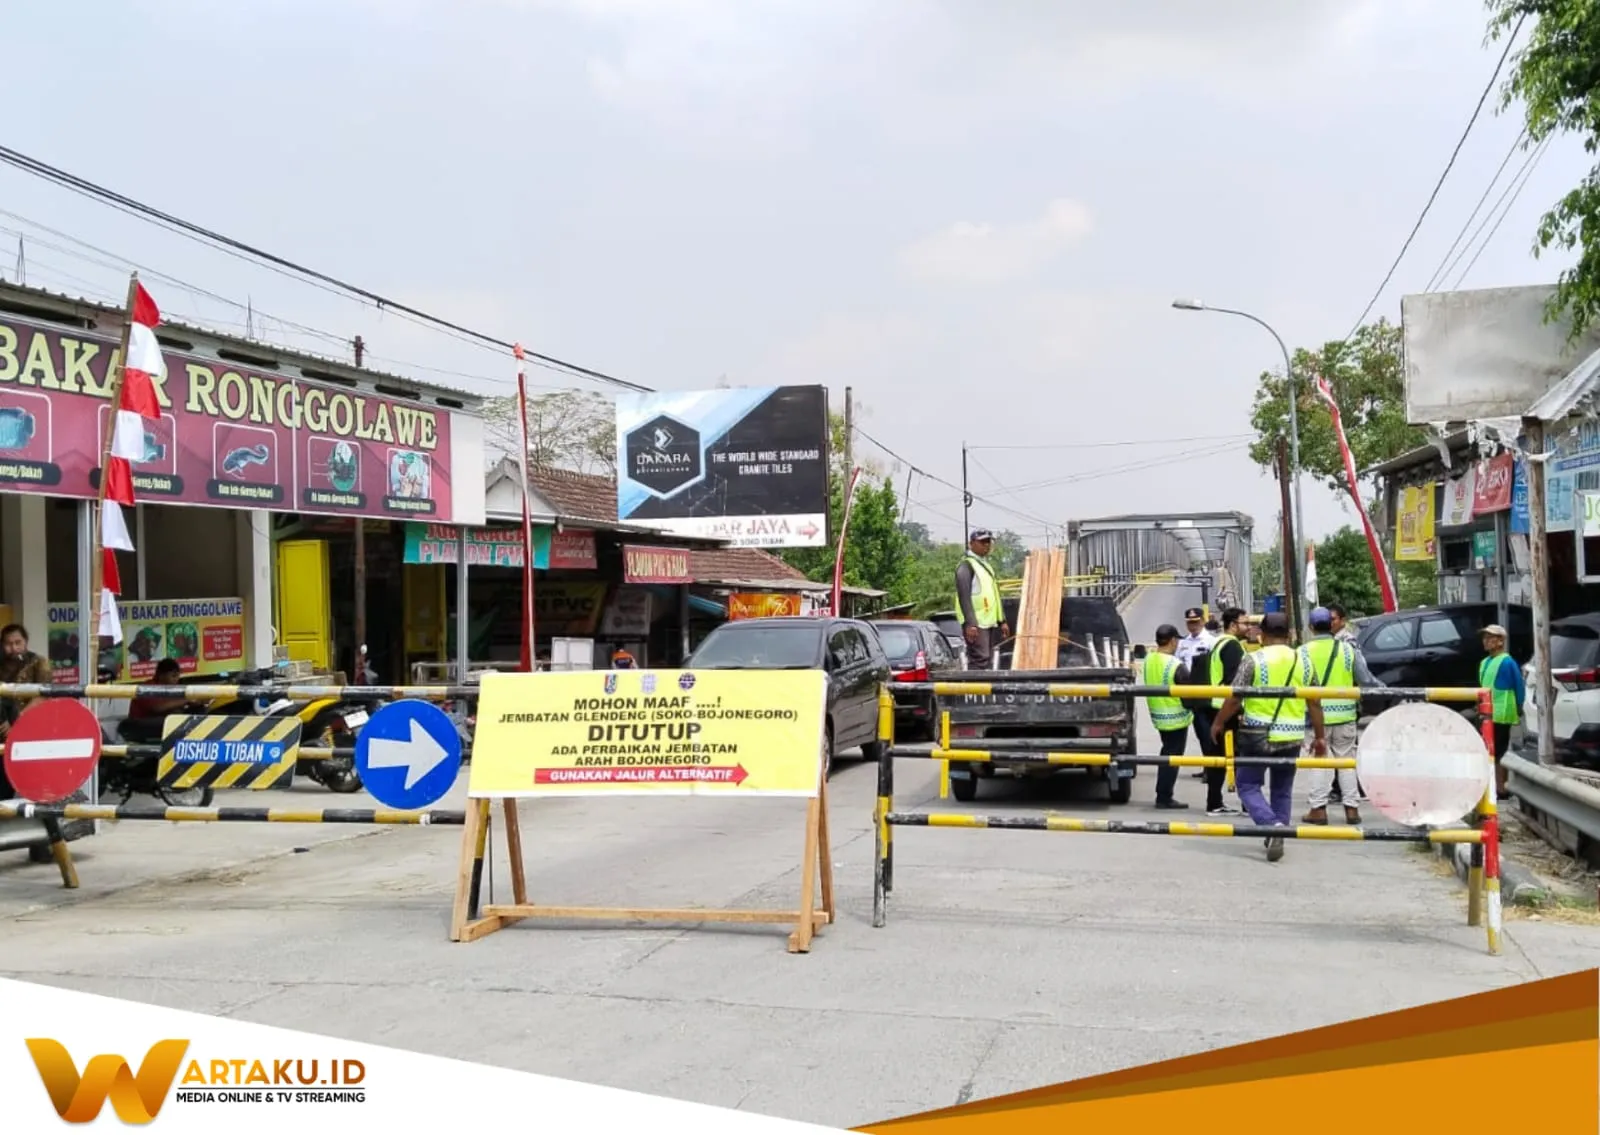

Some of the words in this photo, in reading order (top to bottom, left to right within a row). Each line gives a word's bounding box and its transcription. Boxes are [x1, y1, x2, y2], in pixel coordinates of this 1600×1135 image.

[184, 363, 438, 450] RONGGOLAWE
[636, 452, 691, 465] DAKARA
[712, 453, 726, 463] THE
[728, 452, 756, 462] WORLD
[758, 451, 777, 461] WIDE
[772, 463, 793, 474] TILES
[746, 518, 791, 535] JAYA
[419, 540, 492, 565] PLAON
[132, 605, 169, 621] BAKAR
[172, 602, 242, 618] RONGGOLAWE
[574, 698, 637, 711] MOHON
[643, 696, 691, 709] MAAF
[498, 712, 570, 724] JEMBATAN
[573, 711, 647, 722] GLENDENG
[651, 709, 798, 722] (SOKO-BOJONEGORO)
[588, 723, 702, 742] DITUTUP
[176, 742, 219, 761] DISHUB
[224, 742, 264, 762] TUBAN
[551, 746, 579, 756] ADA
[582, 744, 661, 755] PERBAIKAN
[665, 743, 738, 754] JEMBATAN
[574, 756, 613, 767] ARAH
[617, 755, 711, 766] BOJONEGORO
[549, 770, 612, 782] GUNAKAN
[614, 769, 656, 781] JALUR
[658, 769, 734, 780] ALTERNATIF
